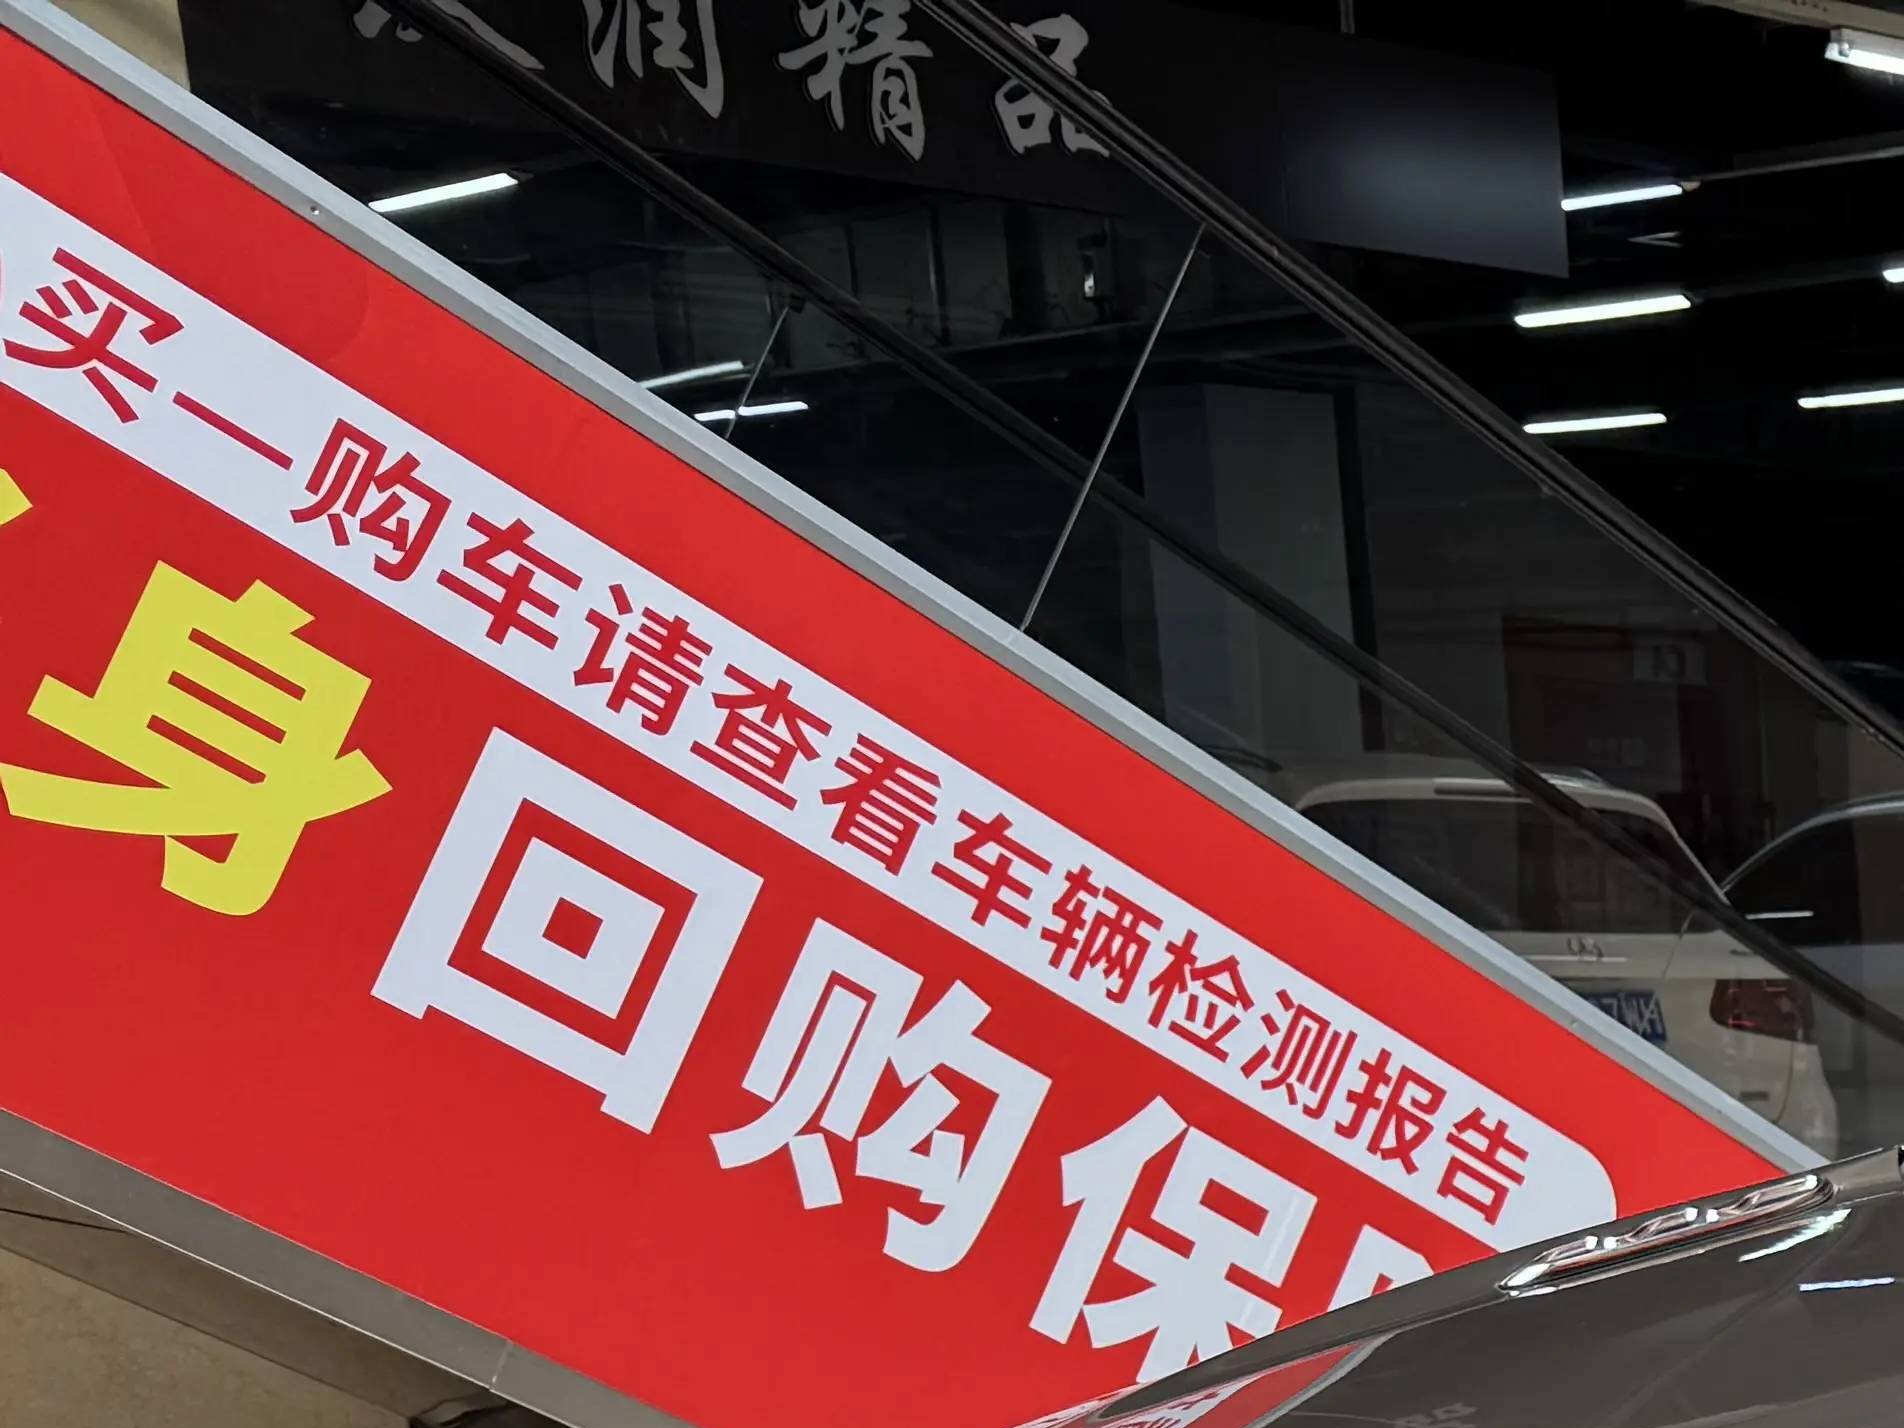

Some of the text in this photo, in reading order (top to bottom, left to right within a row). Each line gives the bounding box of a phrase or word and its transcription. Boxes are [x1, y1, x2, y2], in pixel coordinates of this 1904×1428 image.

[6, 247, 1533, 1228] 买一购车请查看车辆检测报告
